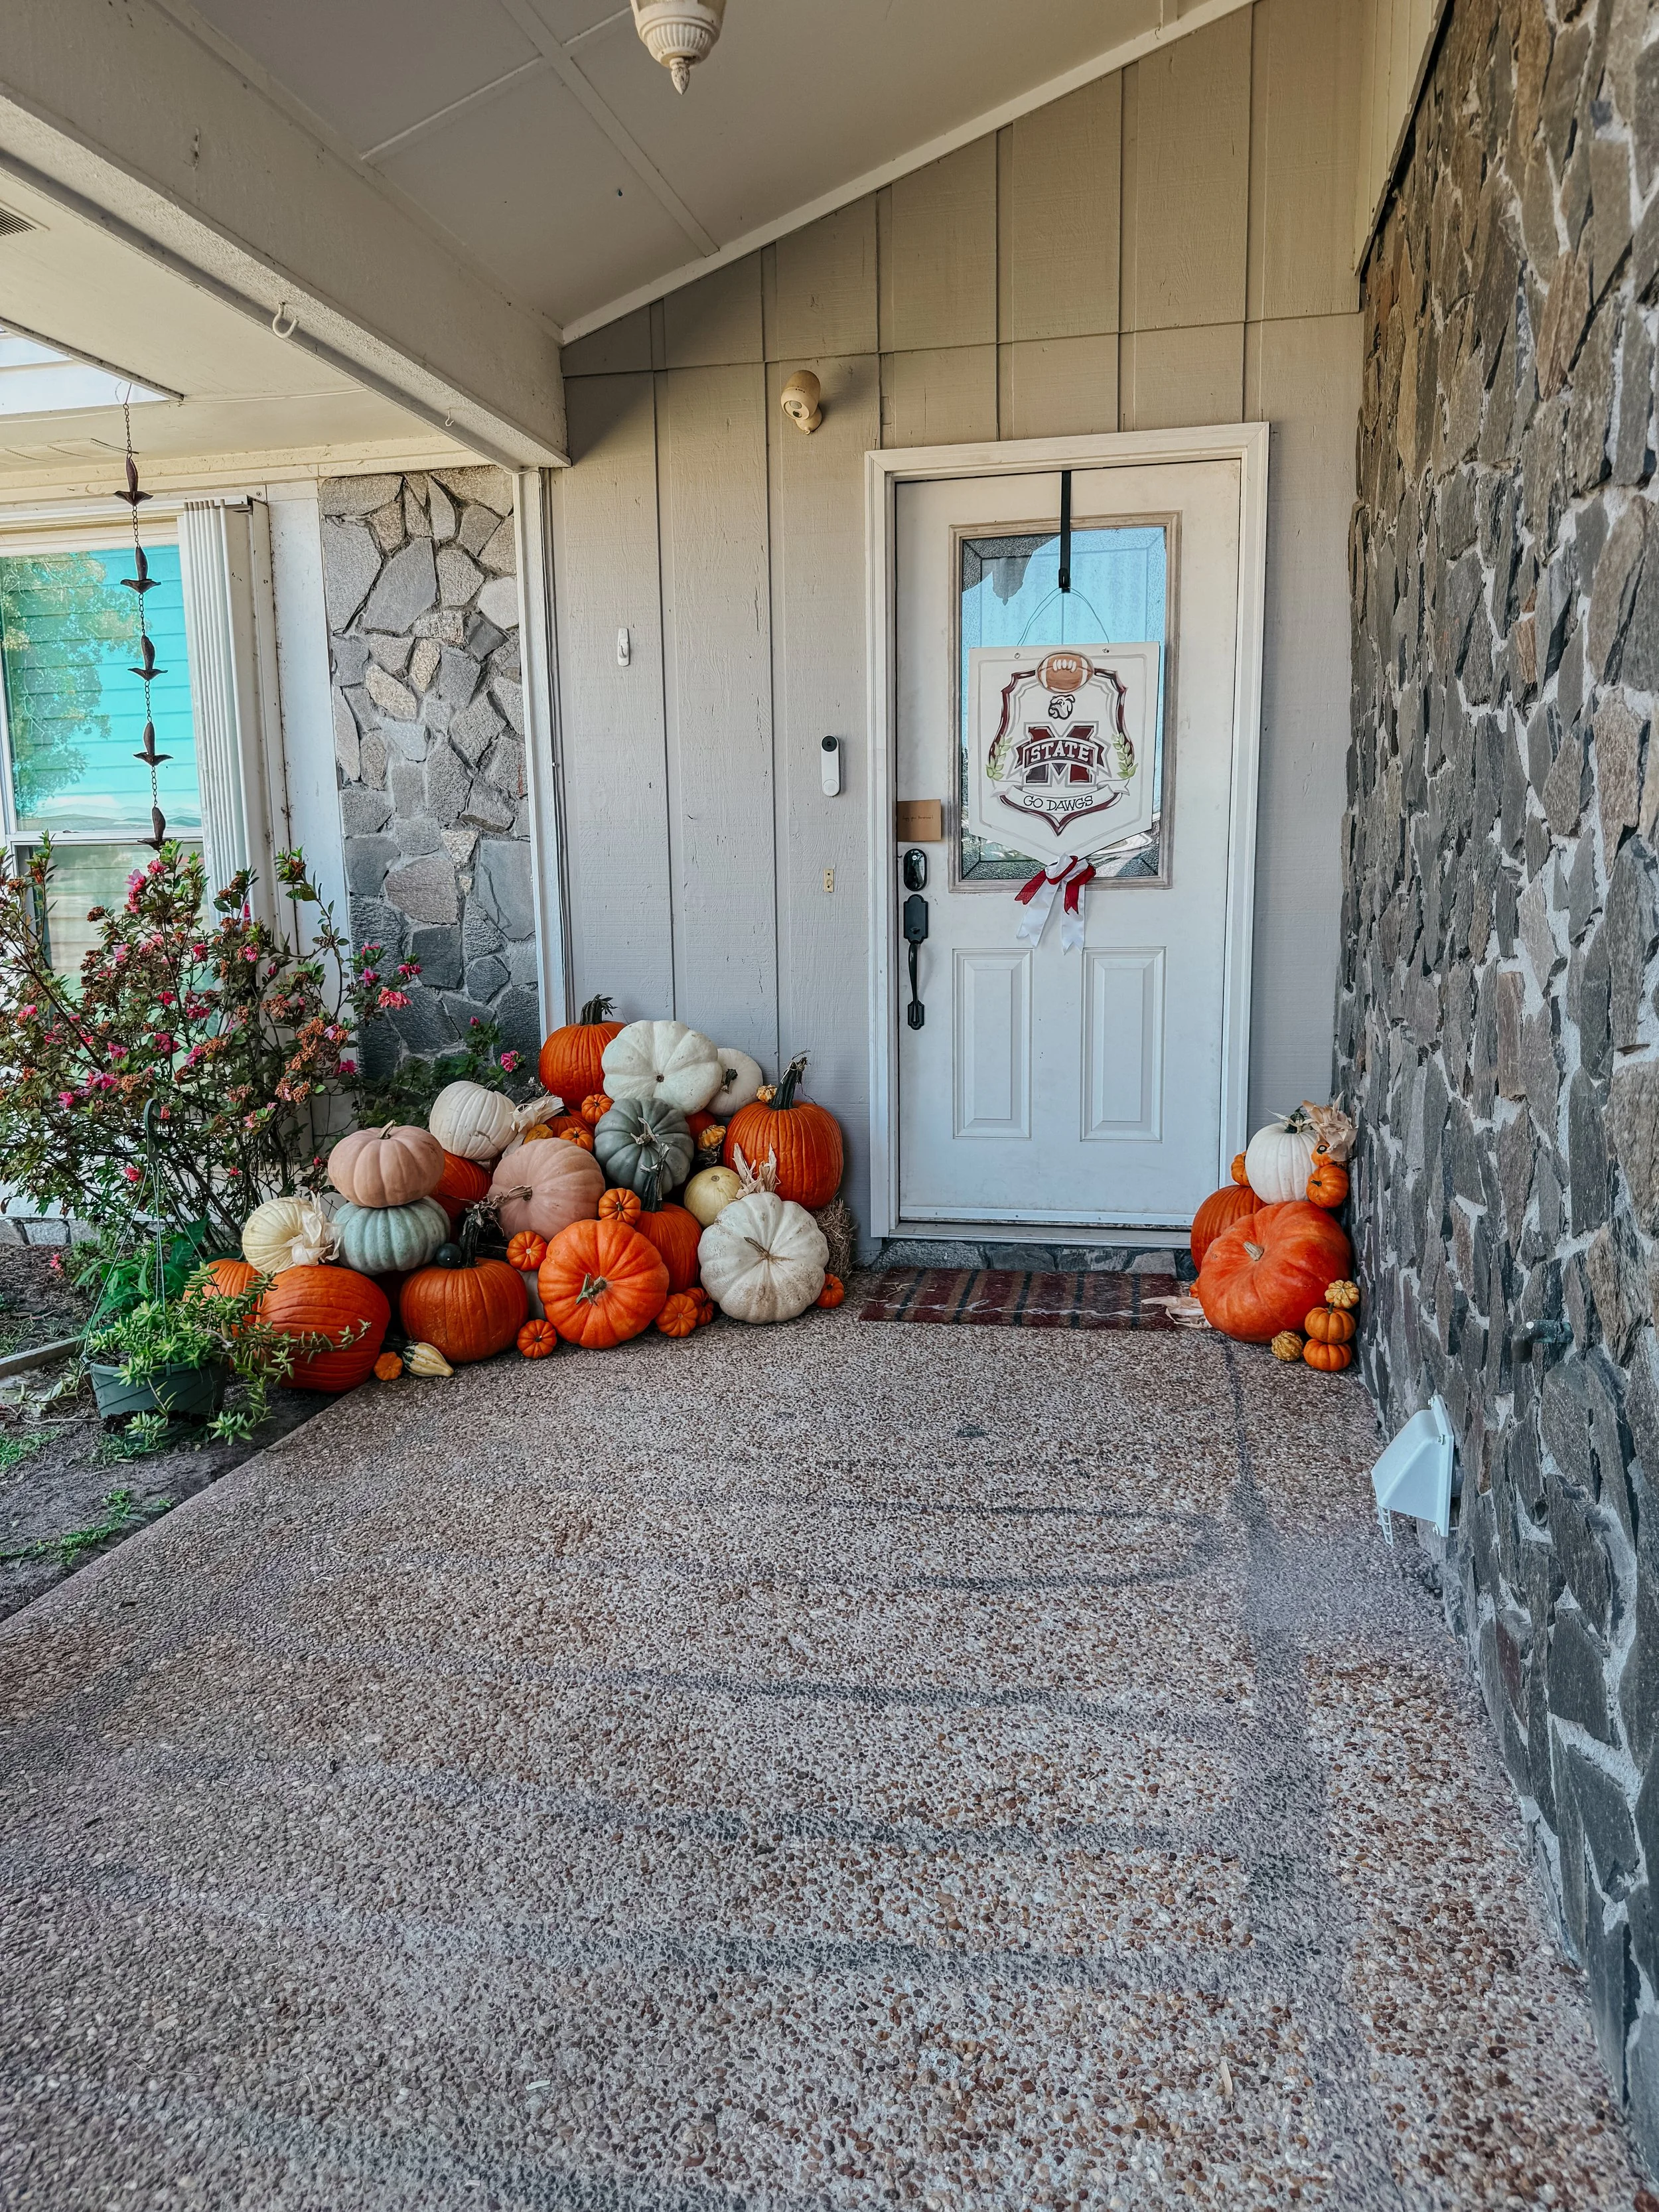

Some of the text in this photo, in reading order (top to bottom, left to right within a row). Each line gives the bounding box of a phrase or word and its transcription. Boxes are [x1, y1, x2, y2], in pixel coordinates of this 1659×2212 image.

[1025, 723, 1097, 786] M
[1031, 741, 1090, 763] STATE
[1023, 795, 1093, 811] GO DAWGS
